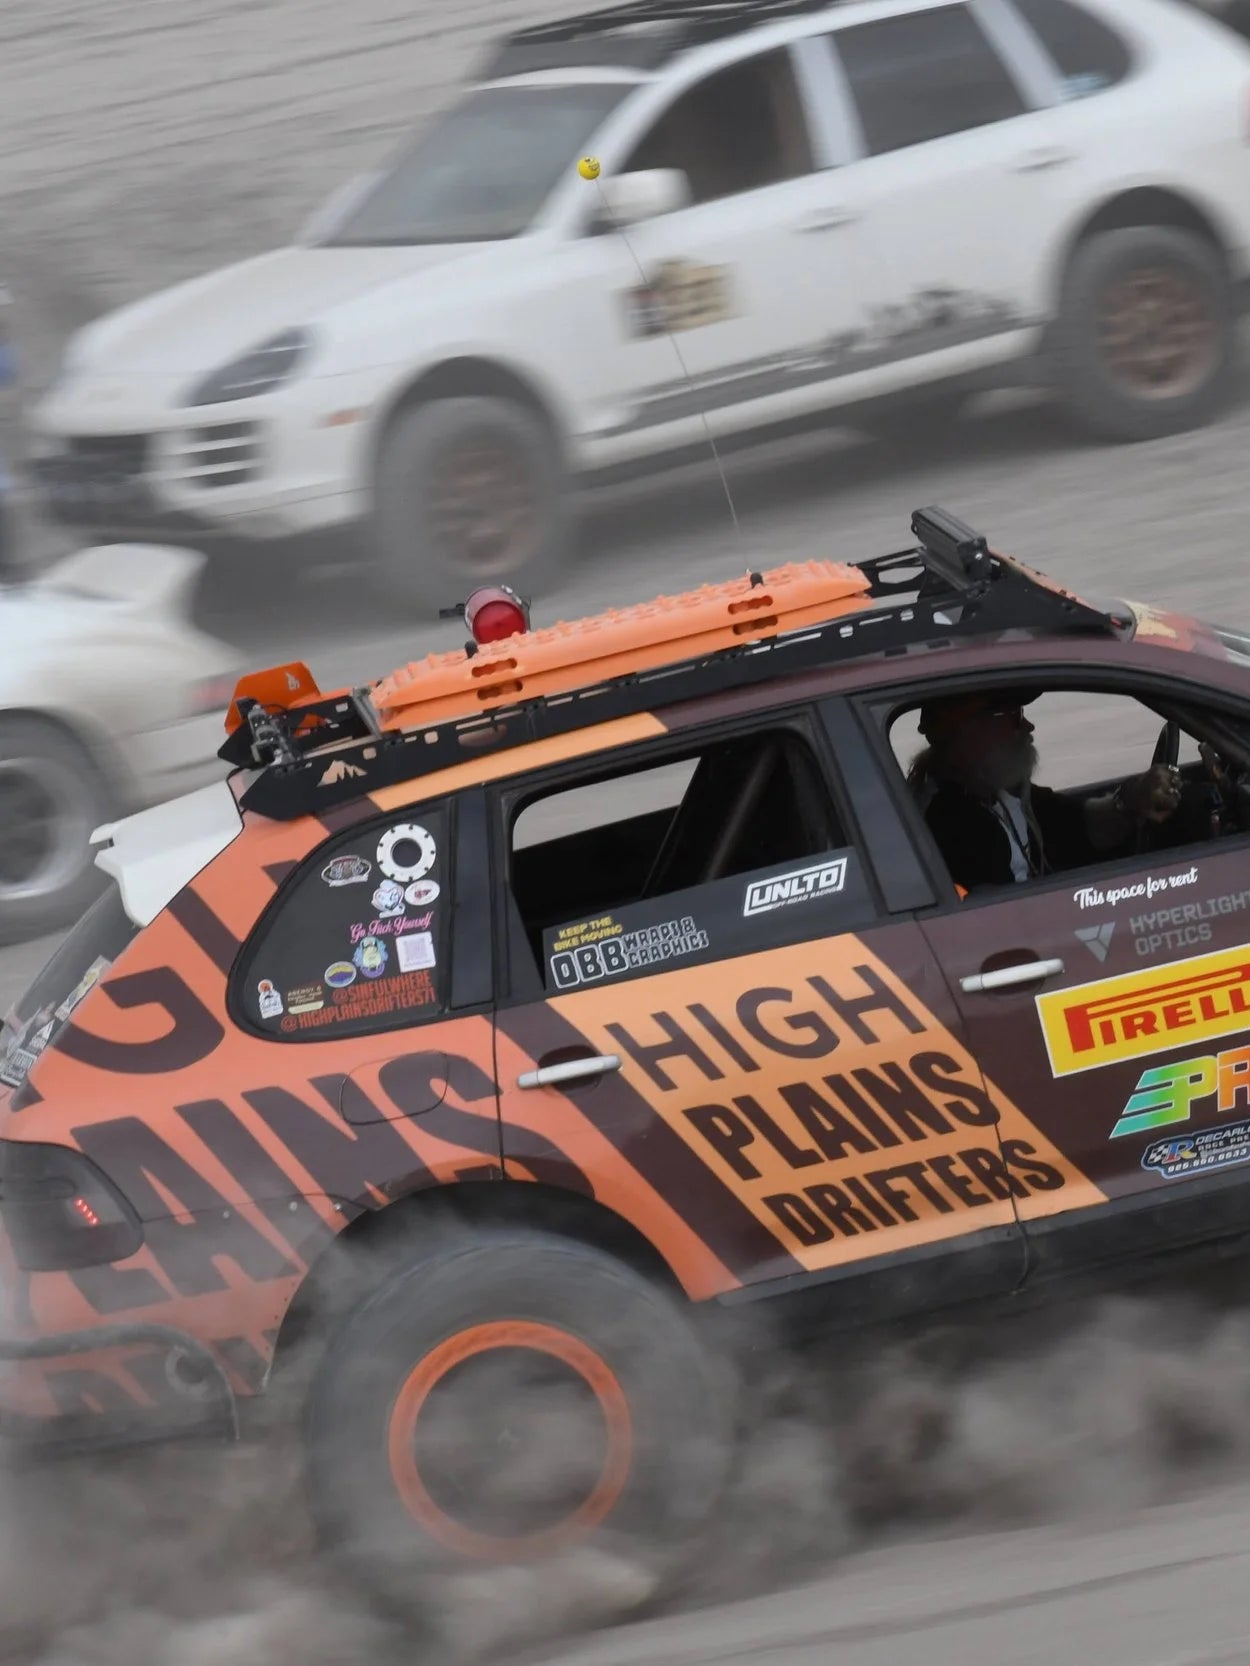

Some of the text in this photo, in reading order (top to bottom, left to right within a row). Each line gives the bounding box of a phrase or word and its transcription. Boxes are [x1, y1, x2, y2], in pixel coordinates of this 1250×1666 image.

[1074, 866, 1198, 909] This space for rent
[554, 924, 623, 952] BIKE MOVING
[559, 916, 612, 939] KEEP THE
[622, 920, 680, 951] WRAPS
[1136, 923, 1213, 956] OPTICS
[626, 930, 709, 968] GRAPHICS
[603, 964, 928, 1092] HIGH
[681, 1051, 1001, 1182] PLAINS
[760, 1138, 1066, 1248] DRIFTERS
